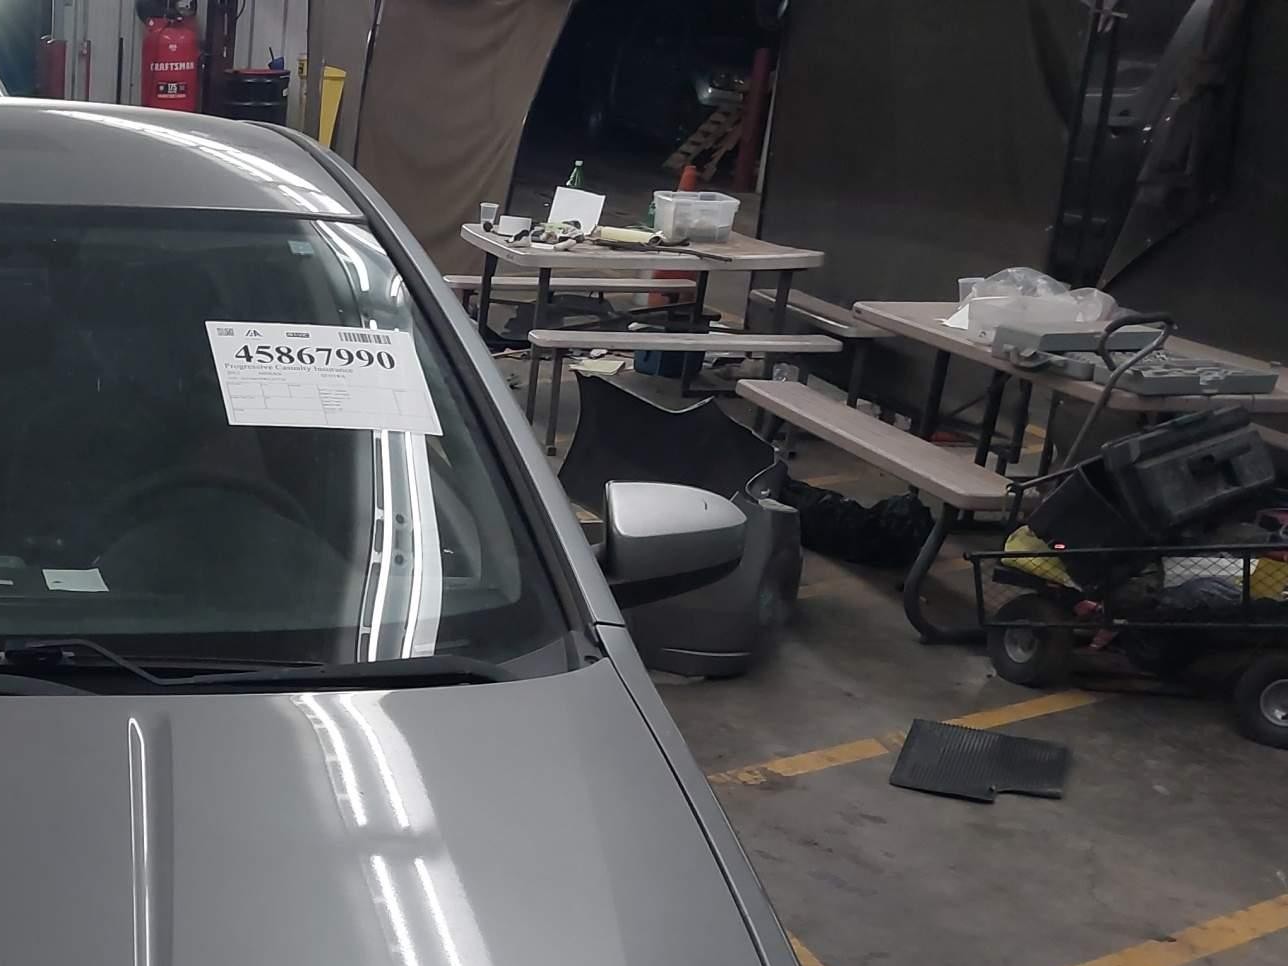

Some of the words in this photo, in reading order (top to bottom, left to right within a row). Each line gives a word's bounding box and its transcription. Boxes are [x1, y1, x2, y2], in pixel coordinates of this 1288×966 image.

[150, 62, 194, 71] CRAFTSMAN
[235, 344, 396, 370] 45867990
[224, 362, 273, 371] Progressive
[275, 364, 312, 373] Casualty
[314, 365, 353, 374] Insurance
